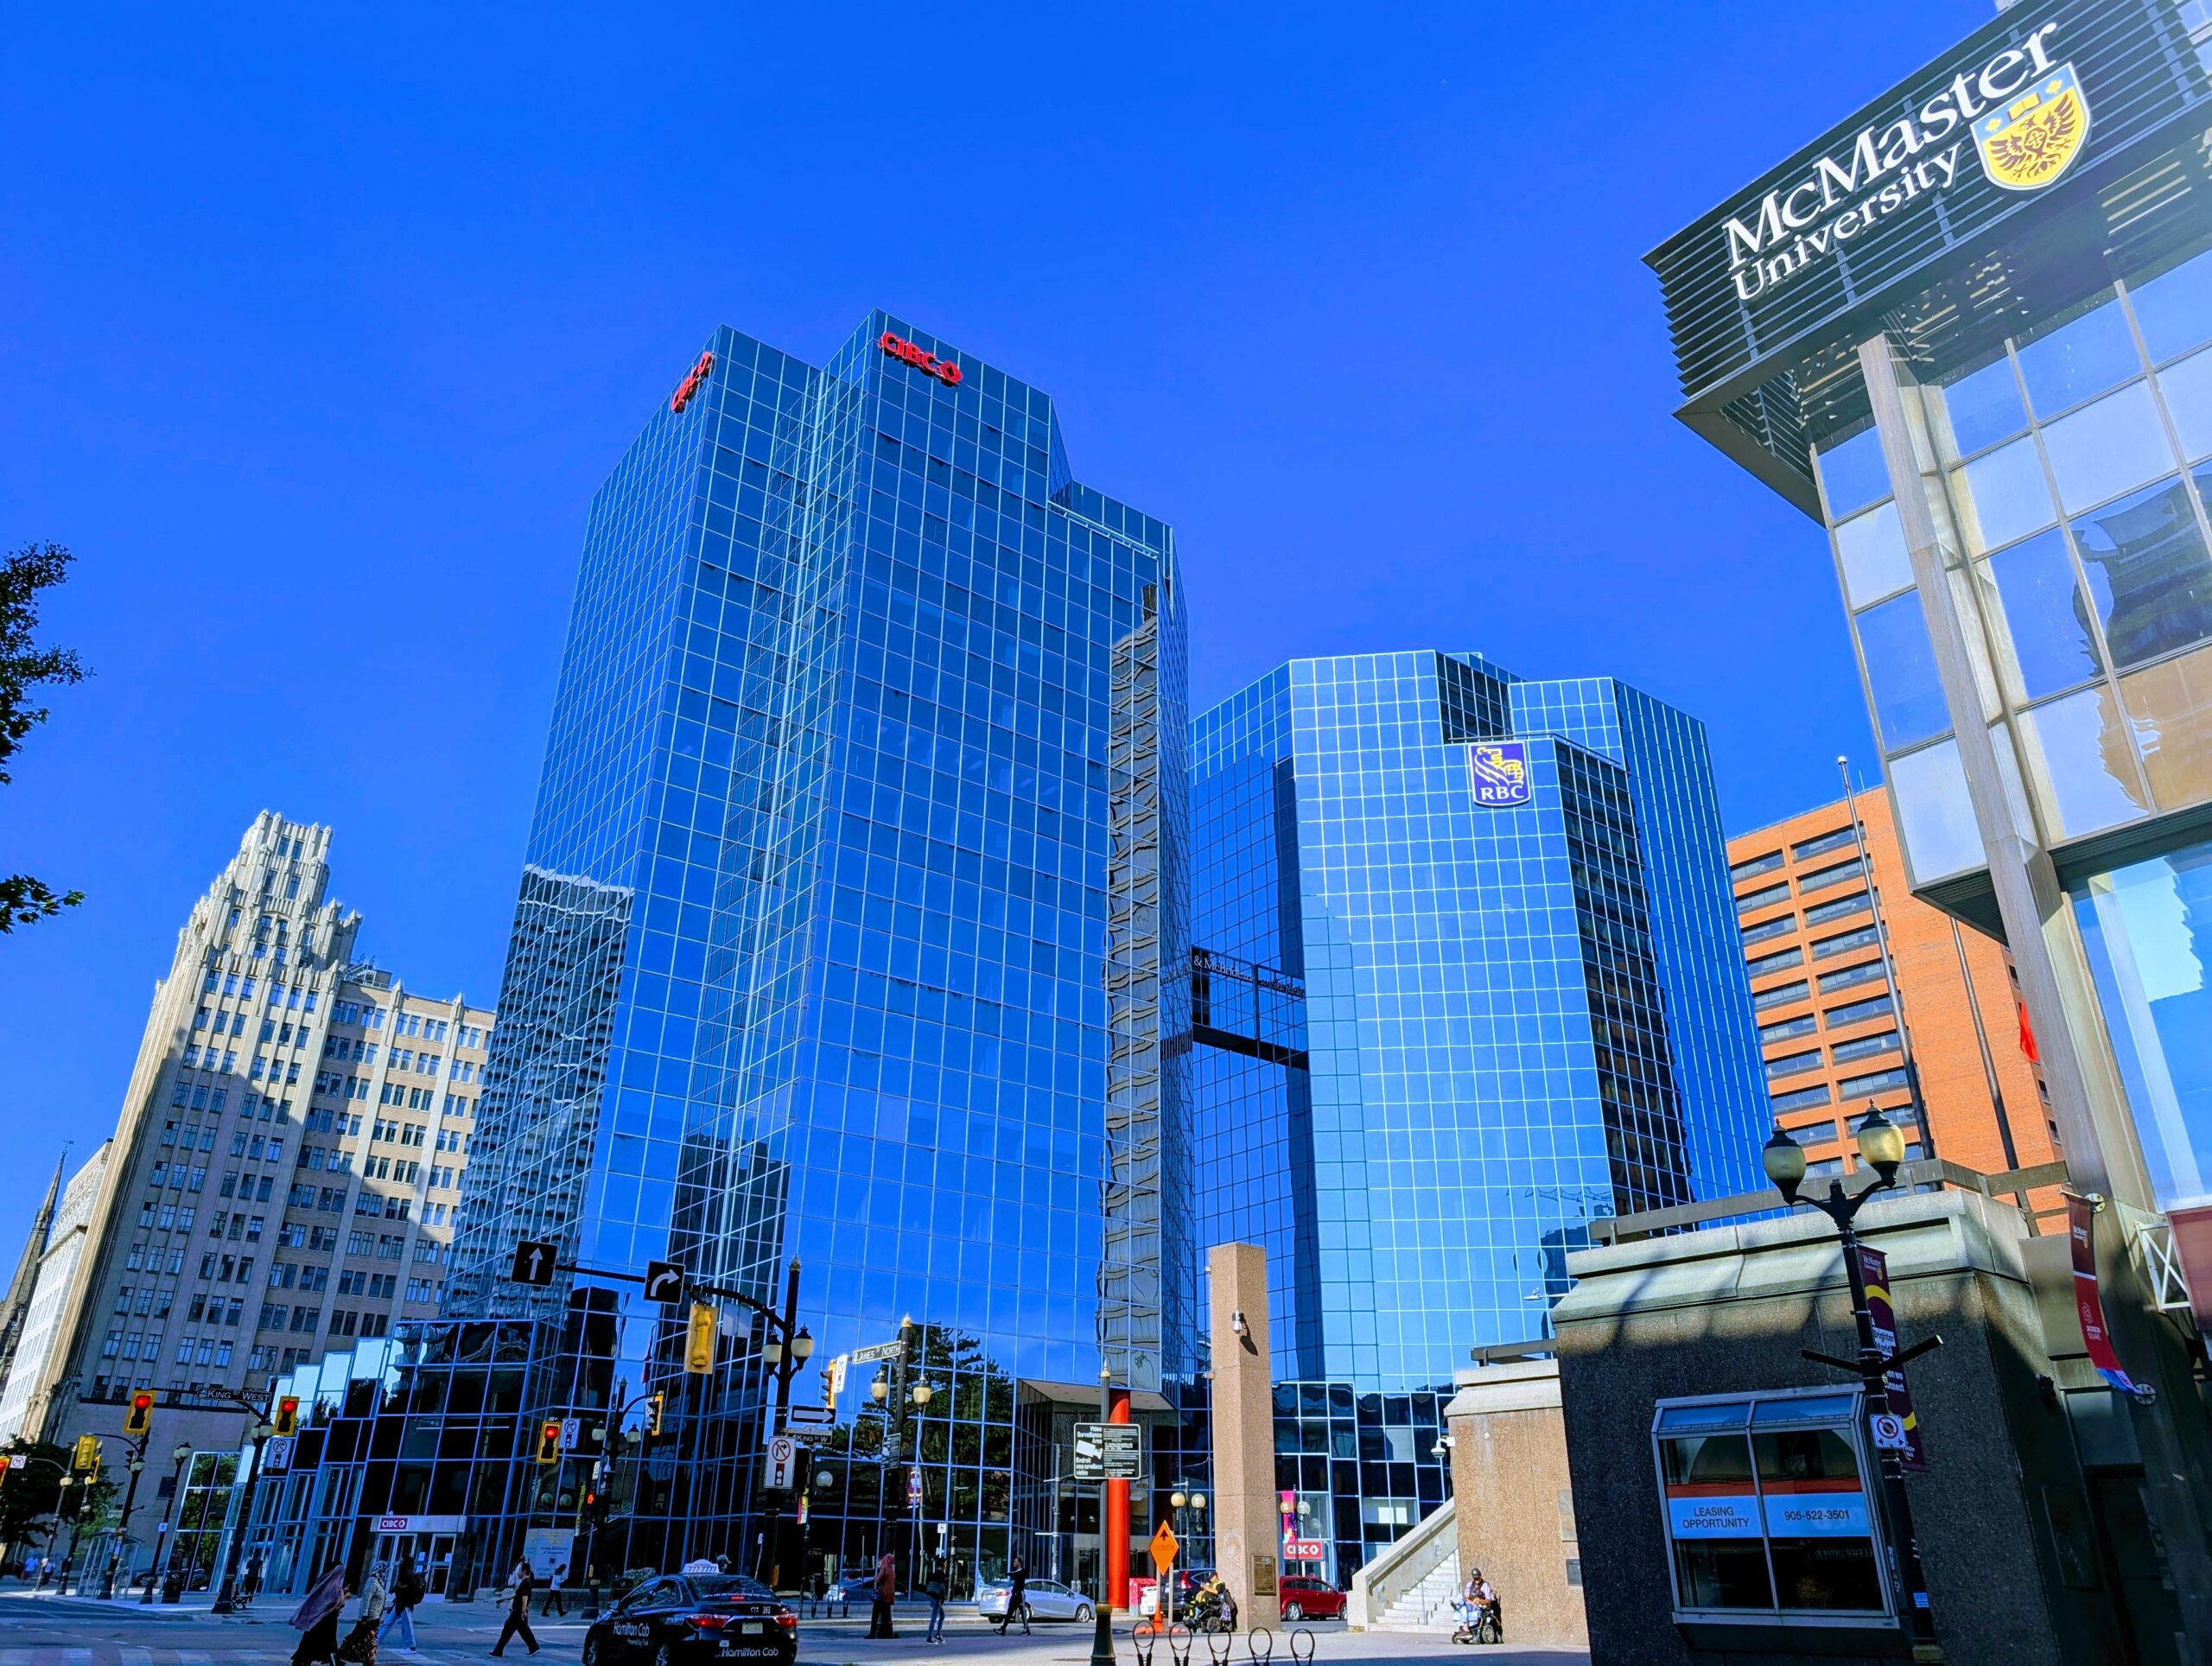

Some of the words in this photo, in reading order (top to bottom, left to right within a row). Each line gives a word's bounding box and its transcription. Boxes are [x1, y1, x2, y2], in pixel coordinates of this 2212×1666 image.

[1721, 22, 2057, 272] McMaster
[1731, 141, 1961, 302] University
[878, 332, 938, 373] CIBC
[1480, 785, 1524, 801] RBC
[1193, 955, 1204, 967] &
[1204, 957, 1243, 979] McBride
[857, 1350, 875, 1362] JAMES
[881, 1345, 899, 1357] NORTH
[207, 1389, 232, 1399] KING
[242, 1392, 270, 1401] WEST
[1694, 1506, 1734, 1517] LEASING
[1784, 1510, 1850, 1521] 905-522-3501
[1682, 1517, 1749, 1529] OPPORTUNITY
[613, 1620, 638, 1637] Hamilton
[638, 1622, 650, 1637] Cab
[721, 1648, 761, 1657] Hamilton
[762, 1647, 779, 1656] Cab
